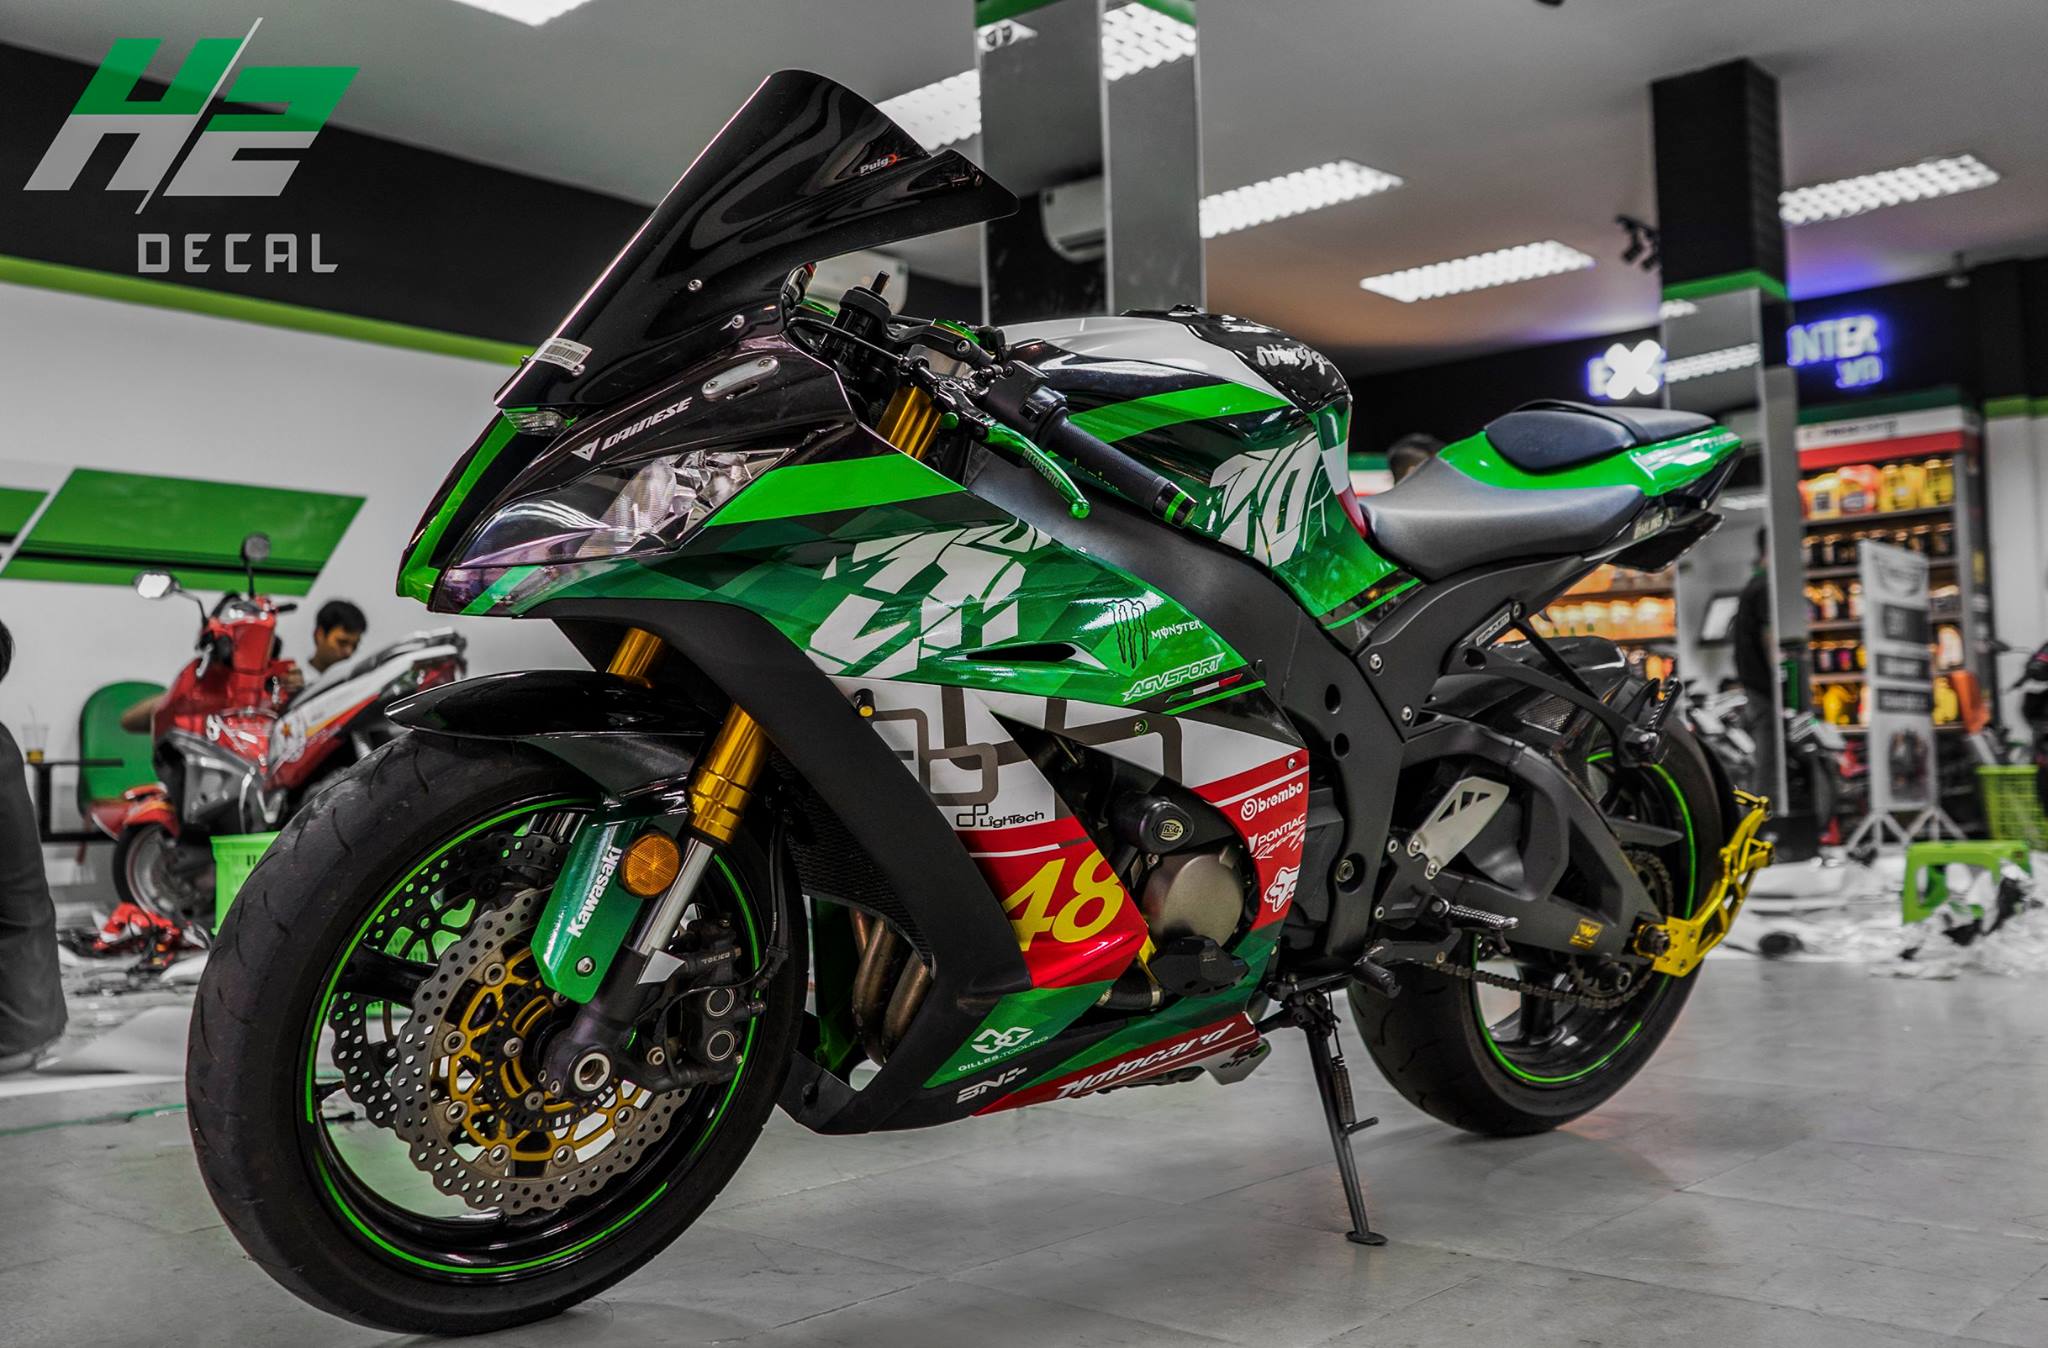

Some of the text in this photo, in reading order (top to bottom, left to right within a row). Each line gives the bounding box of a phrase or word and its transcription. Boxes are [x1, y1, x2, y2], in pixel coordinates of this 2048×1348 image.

[860, 157, 890, 174] Puig
[601, 396, 693, 451] DAINESE
[1151, 619, 1203, 640] MONSTER
[1257, 782, 1304, 813] brembo
[1257, 812, 1306, 847] PONTIAC
[566, 845, 623, 939] Kawasaki
[1001, 849, 1125, 952] 48
